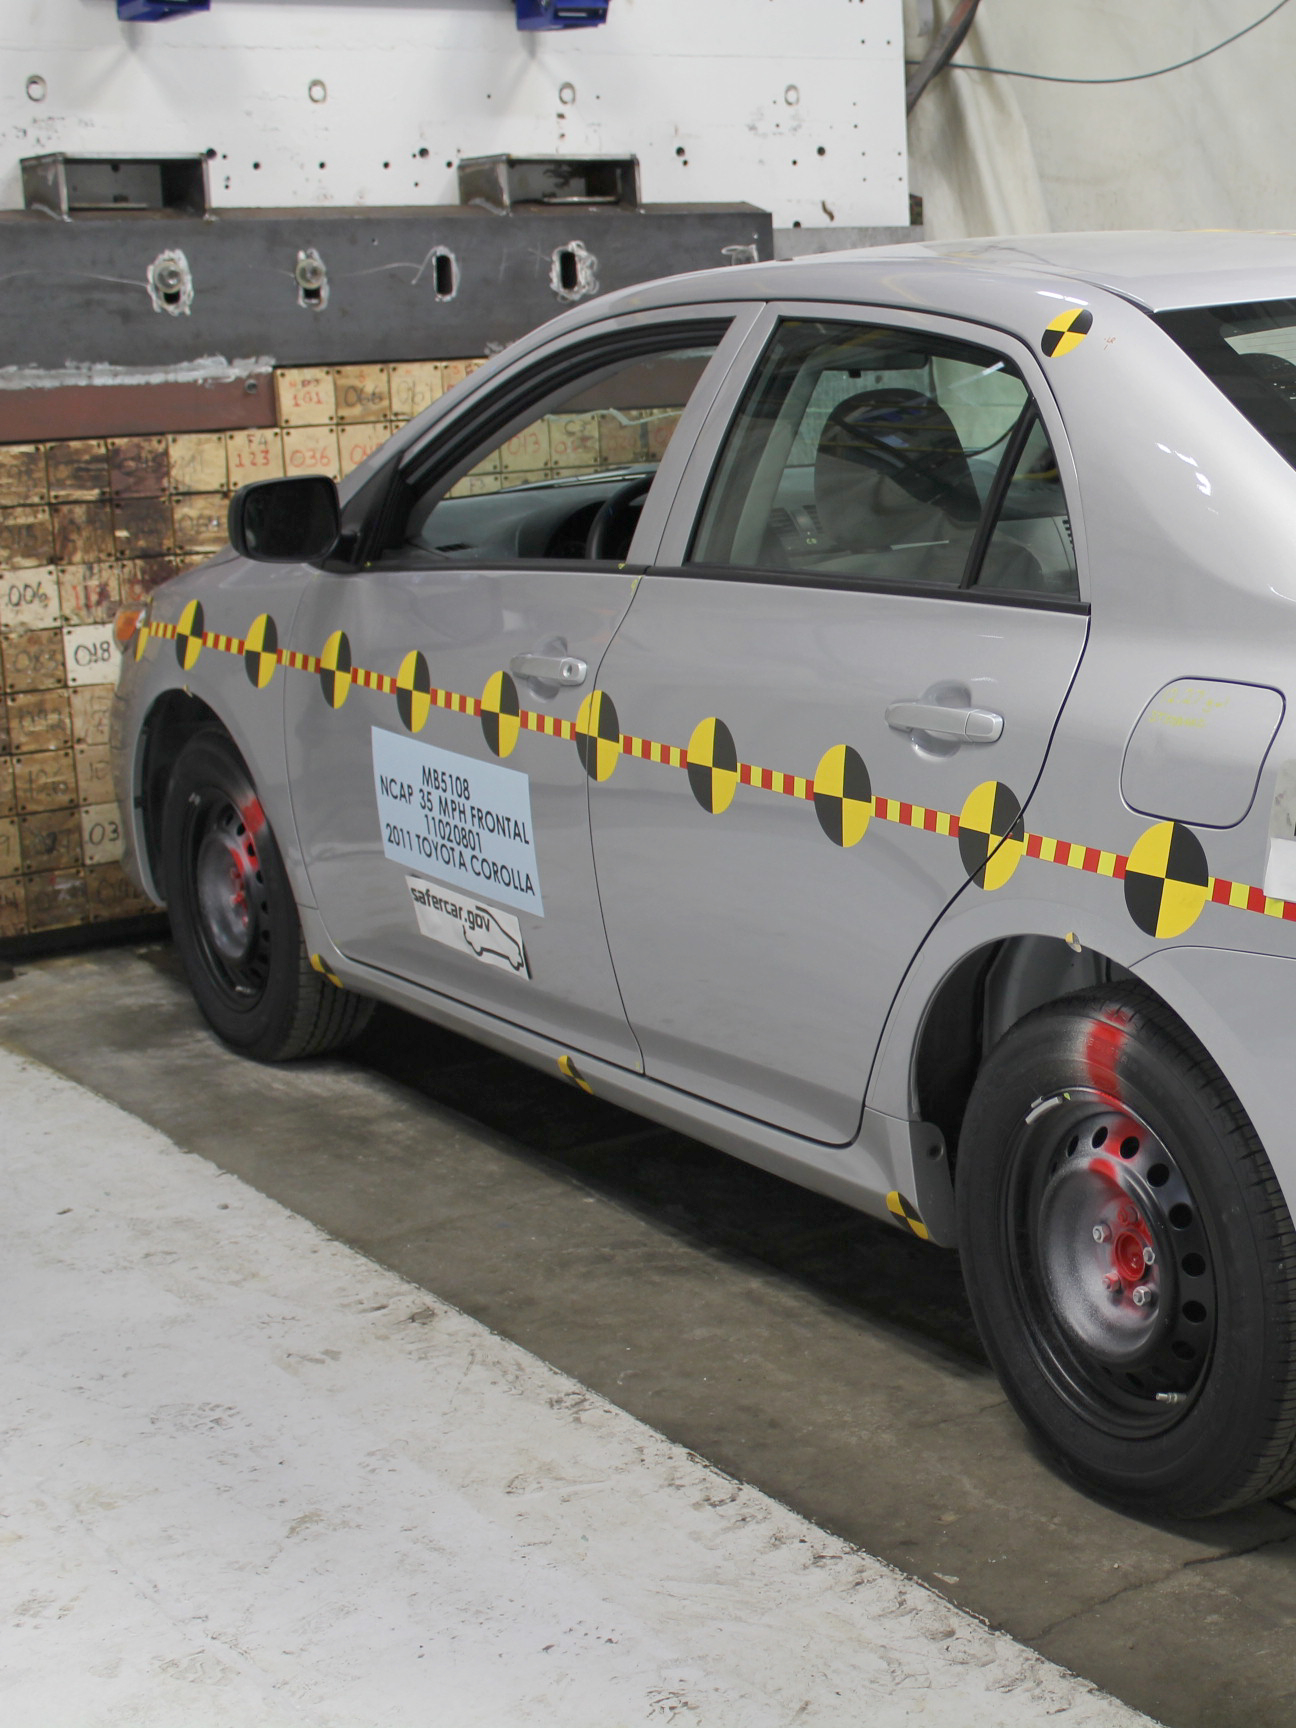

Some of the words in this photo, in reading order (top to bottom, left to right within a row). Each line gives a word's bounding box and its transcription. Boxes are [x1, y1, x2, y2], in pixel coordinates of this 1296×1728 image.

[235, 449, 270, 468] 123
[290, 445, 331, 468] 036
[8, 581, 48, 608] 006
[74, 640, 111, 667] 018
[422, 765, 470, 800] MB5108
[380, 775, 414, 805] NCAP
[419, 788, 434, 812] 35
[438, 795, 467, 825] MPH
[470, 805, 530, 845] FRONTAL
[424, 814, 483, 853] 11020801
[385, 823, 413, 851] 2011
[415, 833, 468, 872] TOYOTA
[470, 854, 535, 896] COROLLA
[410, 886, 491, 932] safercar.gov
